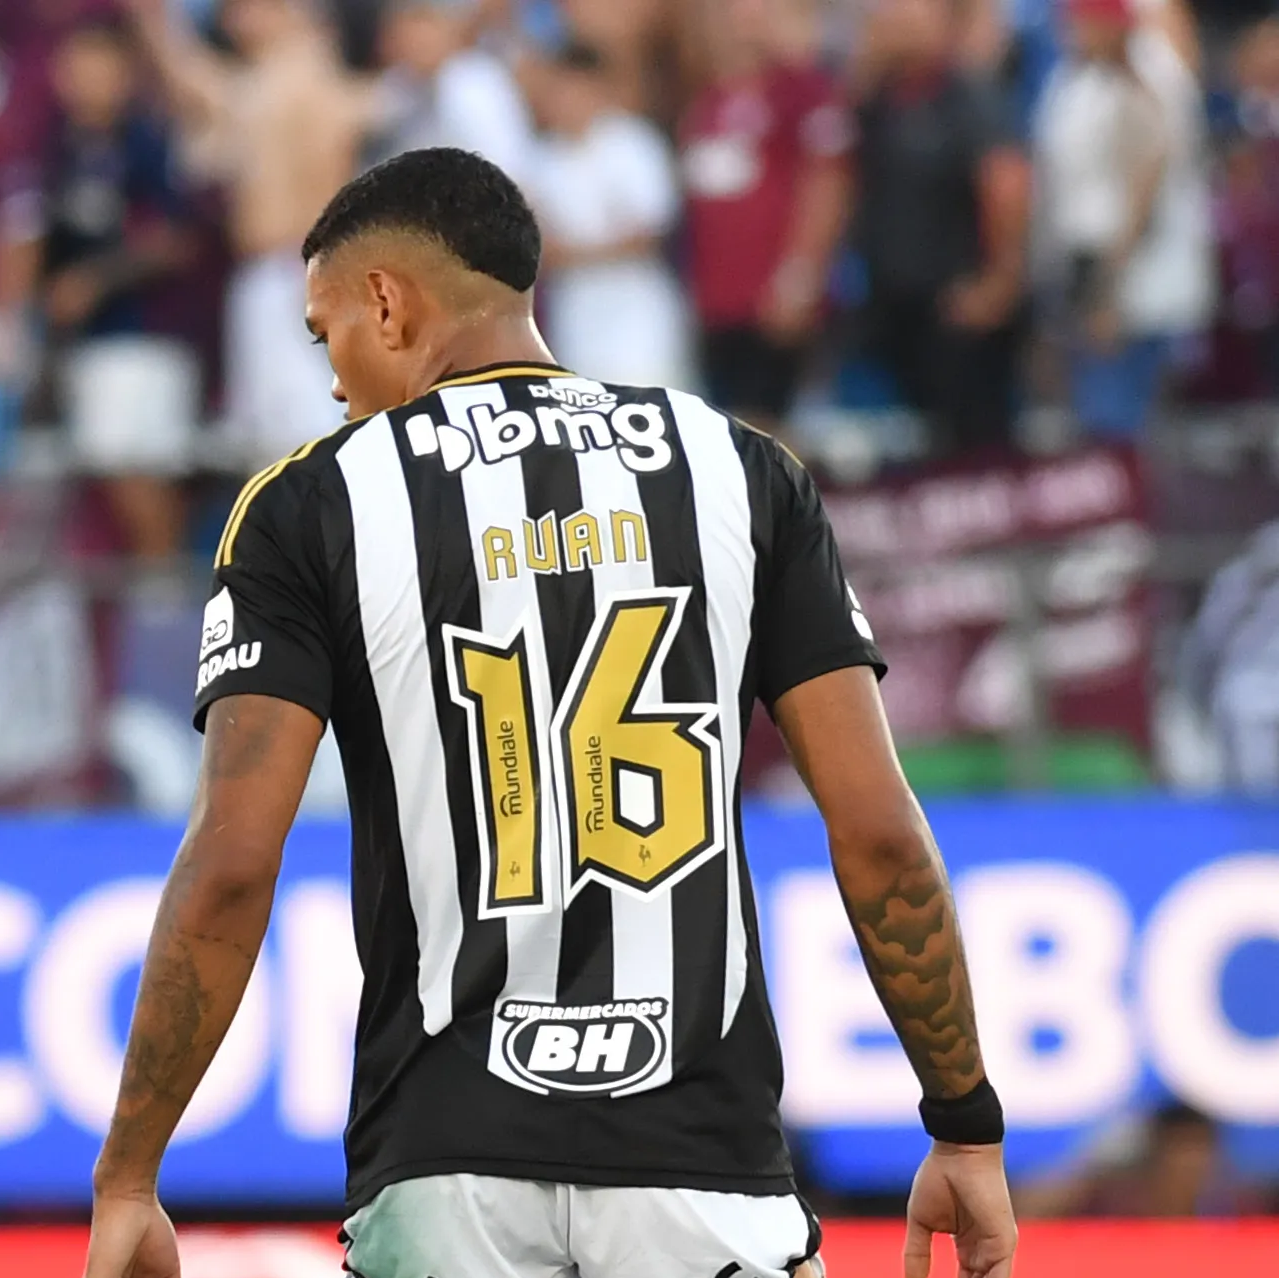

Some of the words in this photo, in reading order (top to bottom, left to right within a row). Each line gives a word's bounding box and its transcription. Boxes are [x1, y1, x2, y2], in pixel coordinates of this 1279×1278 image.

[528, 384, 618, 407] banco
[469, 401, 672, 472] bmg
[481, 508, 649, 581] RUAN
[195, 641, 262, 697] RDAU
[443, 586, 724, 920] 16
[499, 719, 522, 817] mundiale
[585, 735, 604, 833] mundiale
[503, 1000, 663, 1021] SUPERMERCADOS
[527, 1023, 634, 1073] BH
